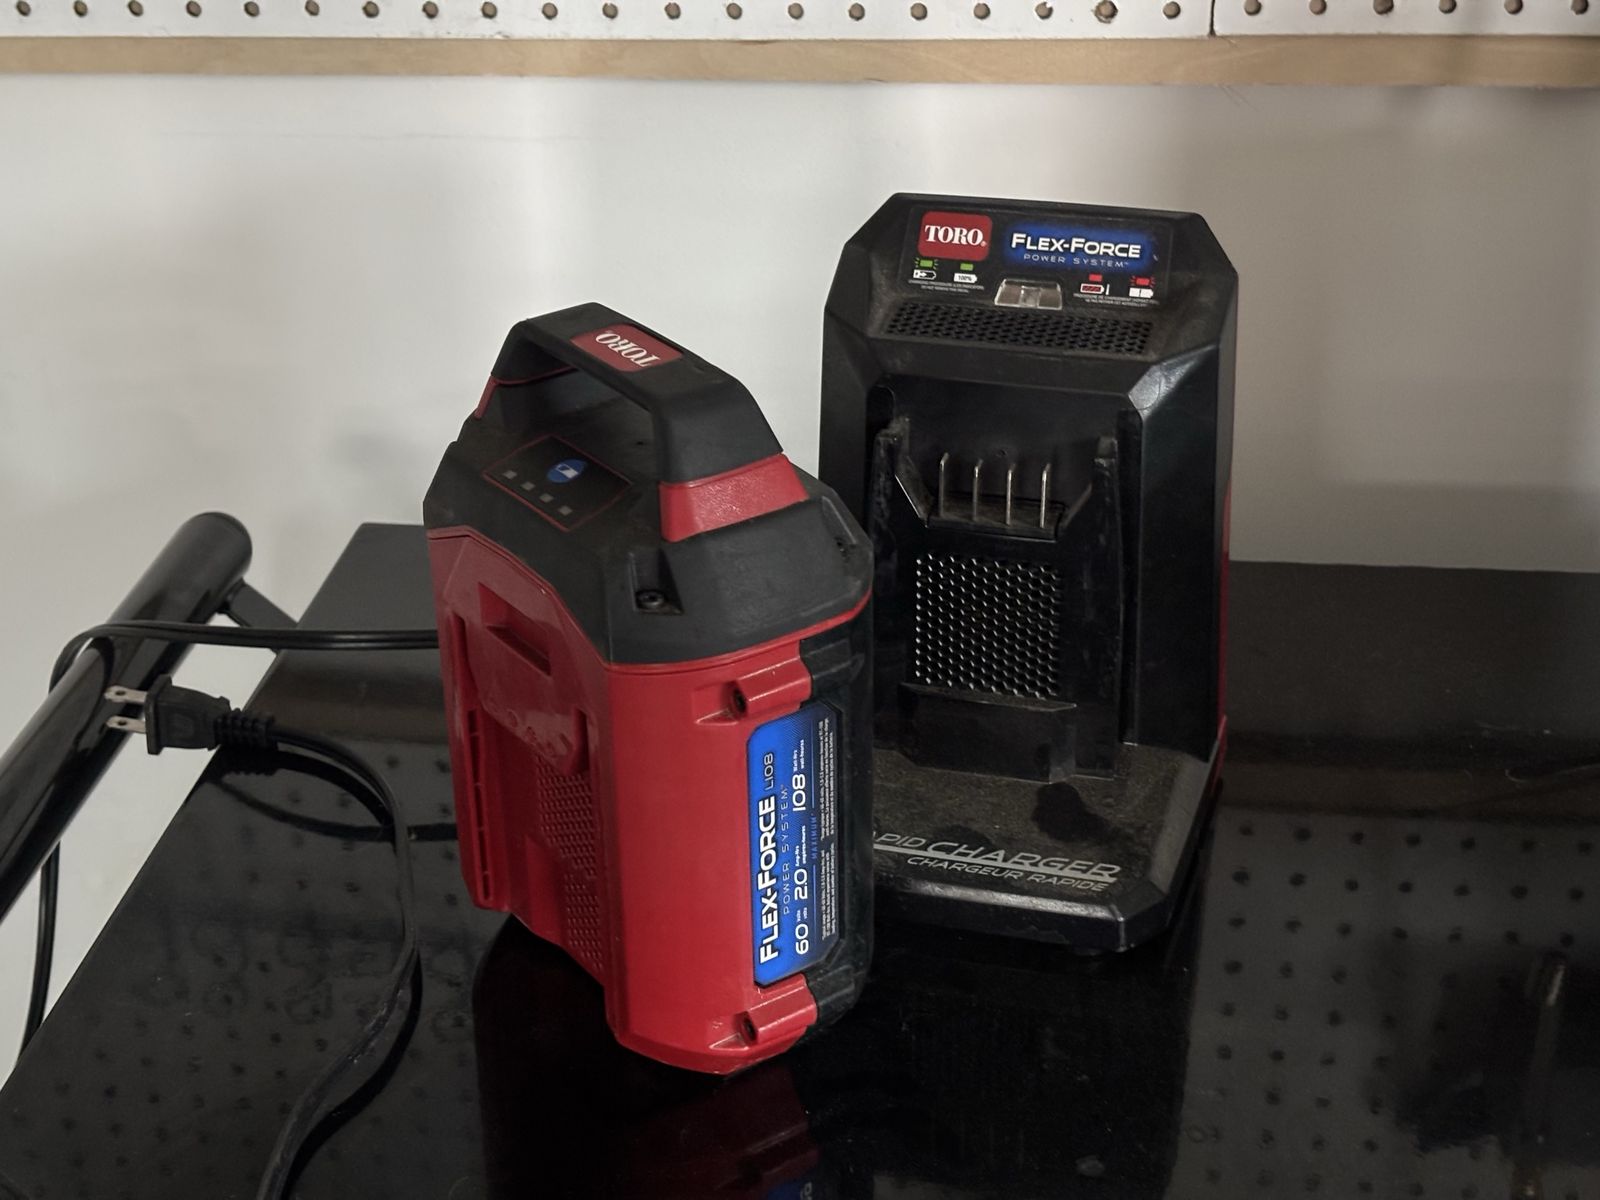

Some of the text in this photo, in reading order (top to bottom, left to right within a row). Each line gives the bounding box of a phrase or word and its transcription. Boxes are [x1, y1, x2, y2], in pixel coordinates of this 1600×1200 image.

[1011, 232, 1141, 258] FLEX-FORCE
[1023, 253, 1066, 264] POWER
[595, 333, 660, 367] TORO
[758, 753, 779, 964] FLEX-FORCE L108
[792, 773, 810, 955] 60 2.0 108
[872, 831, 1121, 878] PID CHARGER
[907, 856, 1110, 893] CHARGEUR RAPIDE
[783, 863, 791, 914] POWER
